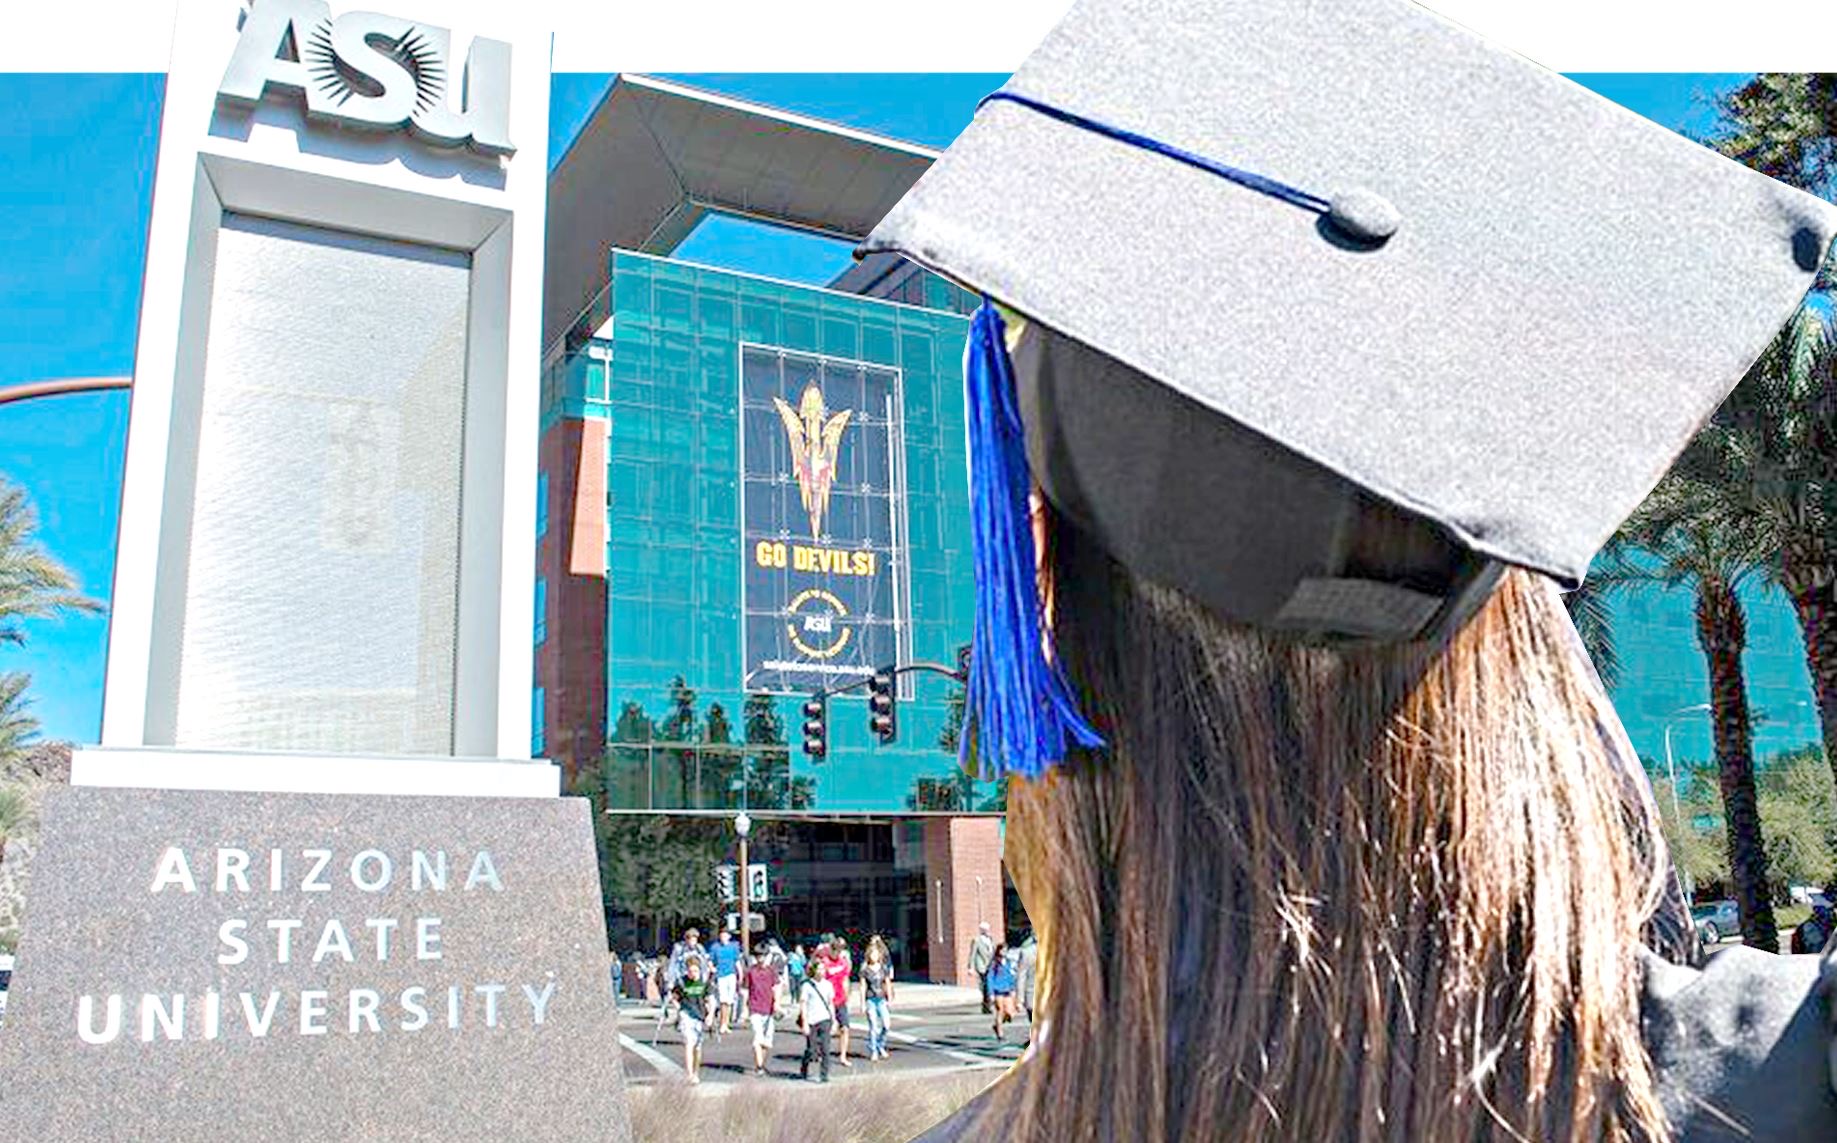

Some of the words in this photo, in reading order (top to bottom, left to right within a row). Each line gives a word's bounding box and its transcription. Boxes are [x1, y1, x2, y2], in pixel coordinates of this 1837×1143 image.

[215, 0, 517, 159] ASU
[756, 541, 787, 568] GO
[793, 546, 876, 576] DEVILS!
[151, 846, 504, 893] ARIZONA
[218, 917, 443, 964] STATE
[77, 982, 557, 1044] UNIVERSITY
